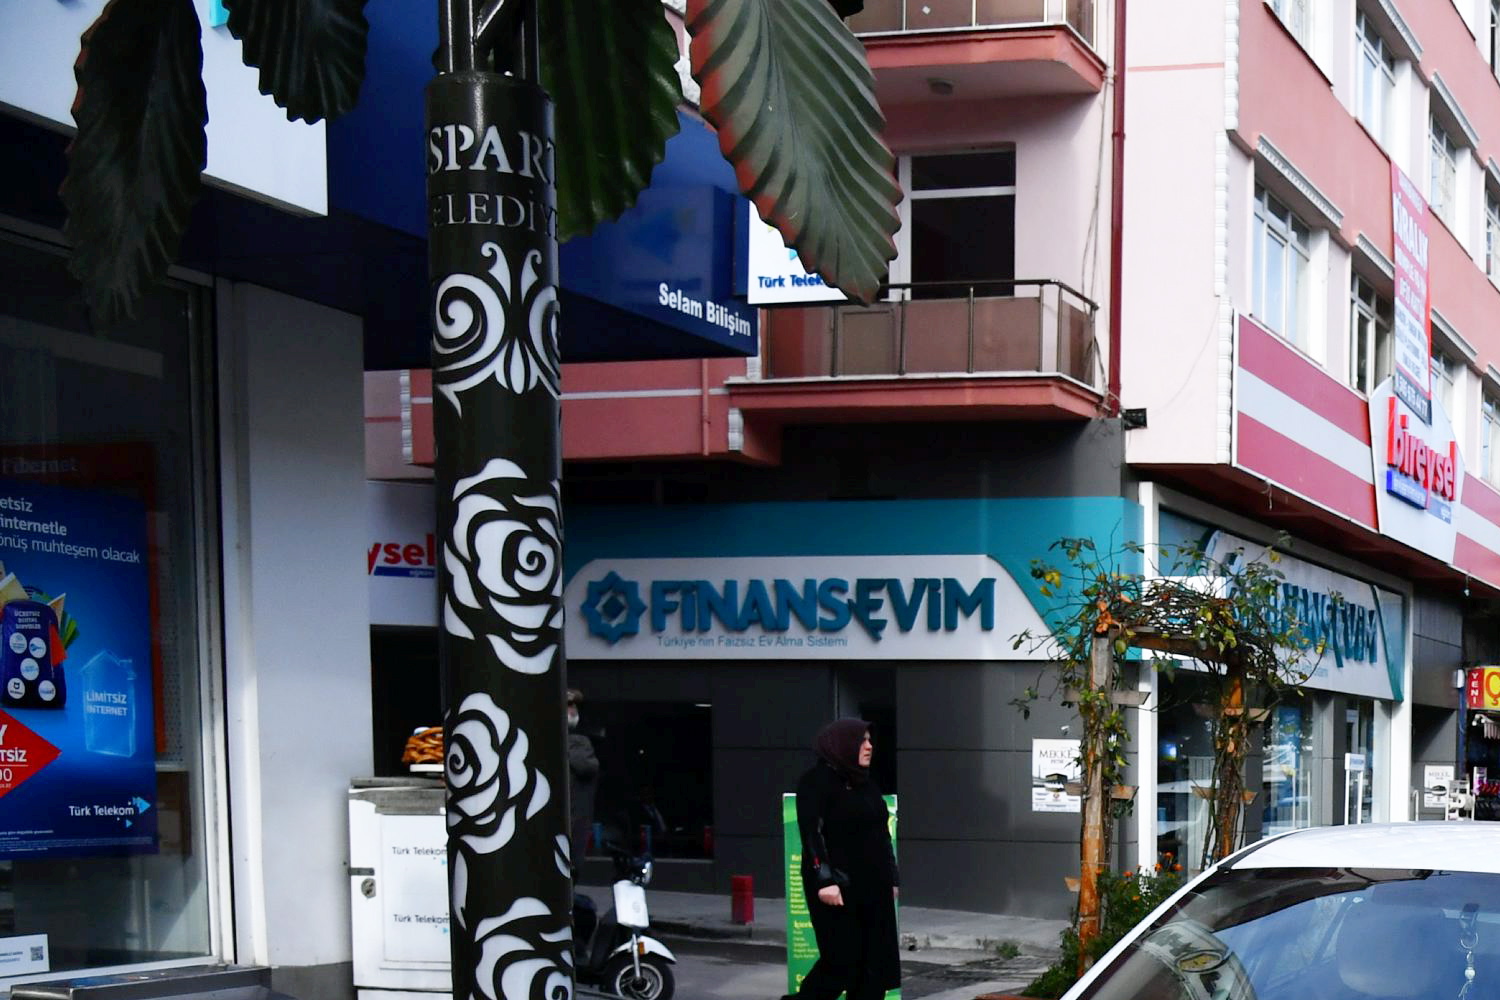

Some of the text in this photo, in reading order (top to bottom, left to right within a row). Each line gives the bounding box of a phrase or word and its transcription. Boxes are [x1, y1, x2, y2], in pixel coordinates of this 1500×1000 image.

[758, 275, 786, 288] Türk
[658, 283, 752, 338] Selam Bilişim
[1387, 397, 1456, 509] bireysel
[31, 536, 98, 559] muhteşem
[101, 547, 141, 564] olacak
[651, 577, 996, 641] FİNANSEVİM
[657, 636, 848, 649] Türkiye'nin Faizsiz Ev Alma Sistemi
[86, 690, 127, 704] LİMİTSİZ
[69, 804, 134, 816] Türk Telekom
[392, 846, 411, 855] Türk
[393, 914, 412, 923] Türk
